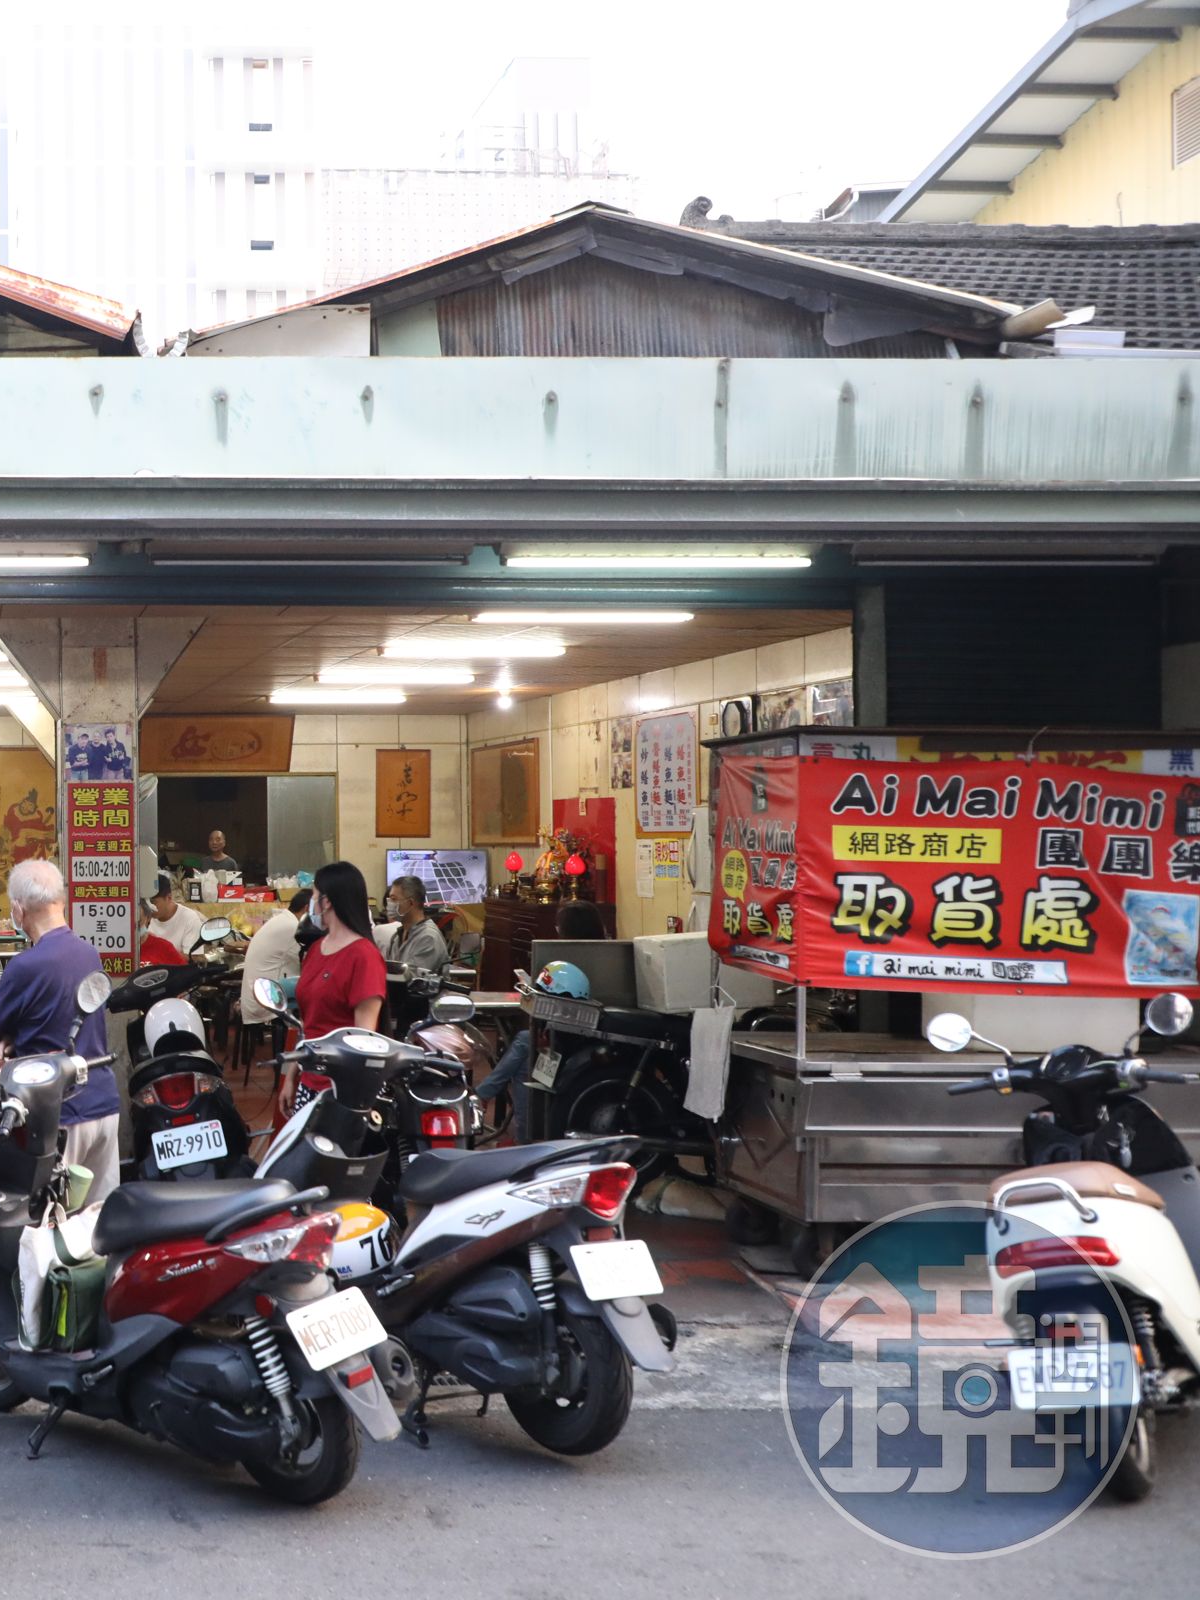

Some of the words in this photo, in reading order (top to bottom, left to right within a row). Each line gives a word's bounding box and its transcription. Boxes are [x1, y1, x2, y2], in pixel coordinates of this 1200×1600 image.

[73, 787, 129, 806] 營業
[831, 772, 899, 816] Ai
[913, 774, 1022, 819] Mai
[1033, 778, 1166, 831] Mimi
[73, 809, 129, 828] 時間
[73, 840, 132, 852] 週一至週五
[849, 831, 988, 859] 網路商店
[73, 860, 130, 877] 15:00-21:00
[75, 885, 129, 898] 週六至週日
[80, 904, 126, 917] 15:00
[832, 873, 1097, 952] 取貨處
[96, 920, 108, 933] 至
[103, 958, 132, 973] 公休日
[907, 962, 936, 977] mai
[944, 963, 984, 979] mimi
[156, 1130, 222, 1160] MRZ-9910
